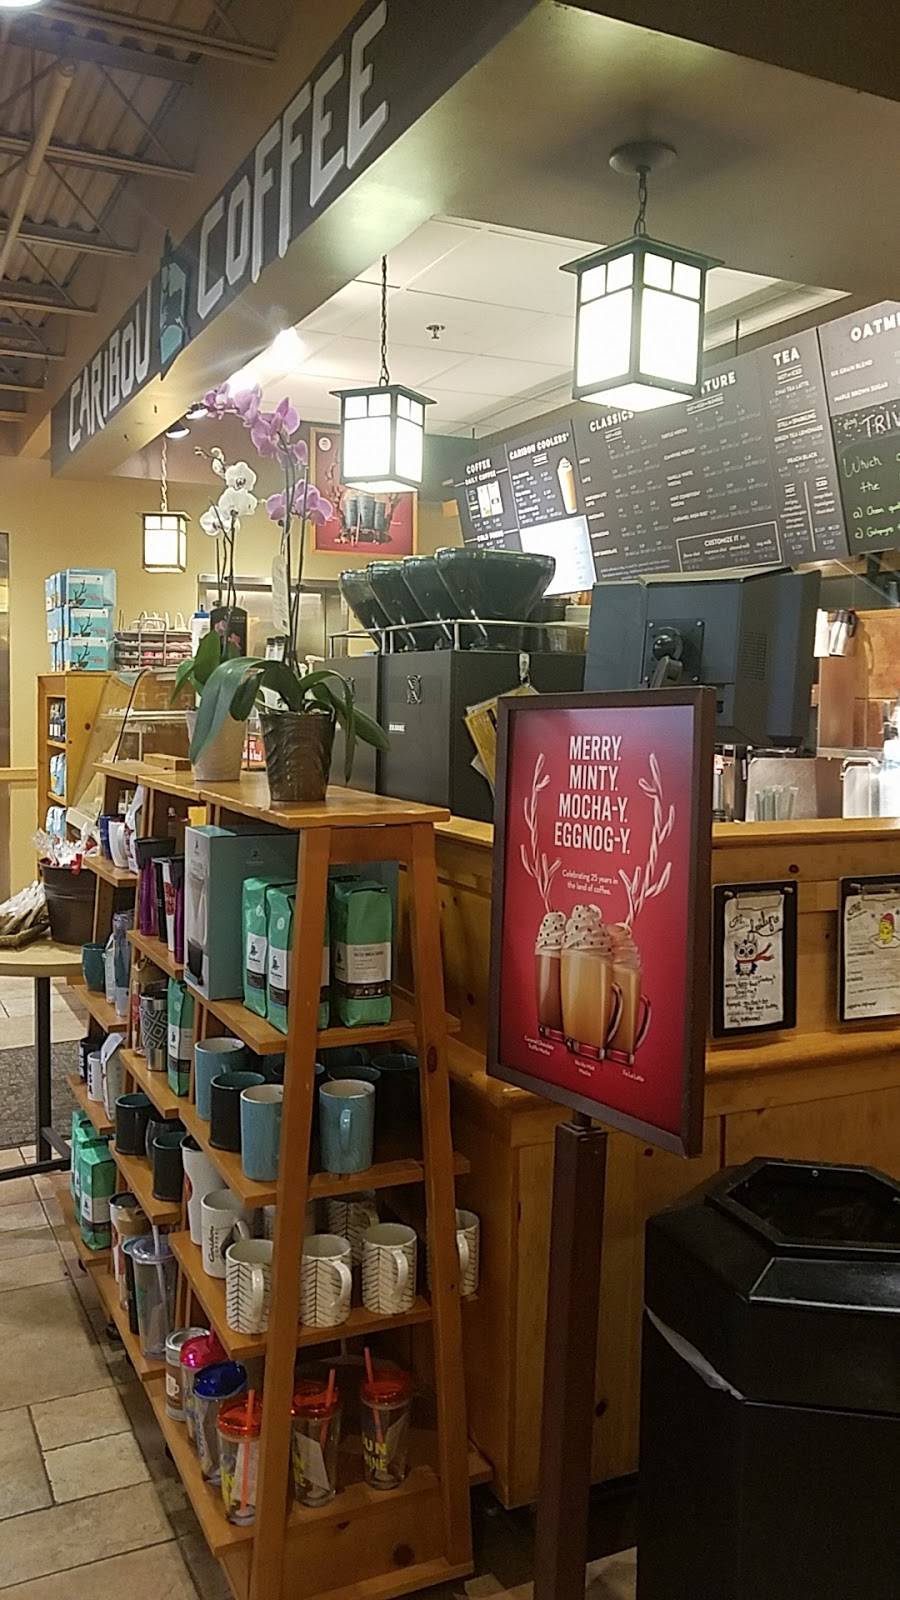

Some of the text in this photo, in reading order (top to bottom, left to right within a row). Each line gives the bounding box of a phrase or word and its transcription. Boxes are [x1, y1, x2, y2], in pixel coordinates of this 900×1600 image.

[69, 1, 389, 452] CARIBOU COFFEE
[773, 347, 800, 366] TEA
[509, 444, 536, 460] CARIBOU
[466, 458, 491, 474] COFFEE
[569, 735, 622, 761] MERRY.
[569, 764, 618, 792] MINTY.
[559, 793, 628, 823] MOCHA-Y.
[554, 821, 630, 854] EGGNOG-Y.
[562, 869, 590, 883] Celebrating
[598, 876, 612, 884] years
[612, 876, 618, 884] in
[567, 880, 576, 889] the
[576, 881, 588, 891] land
[588, 883, 593, 892] of
